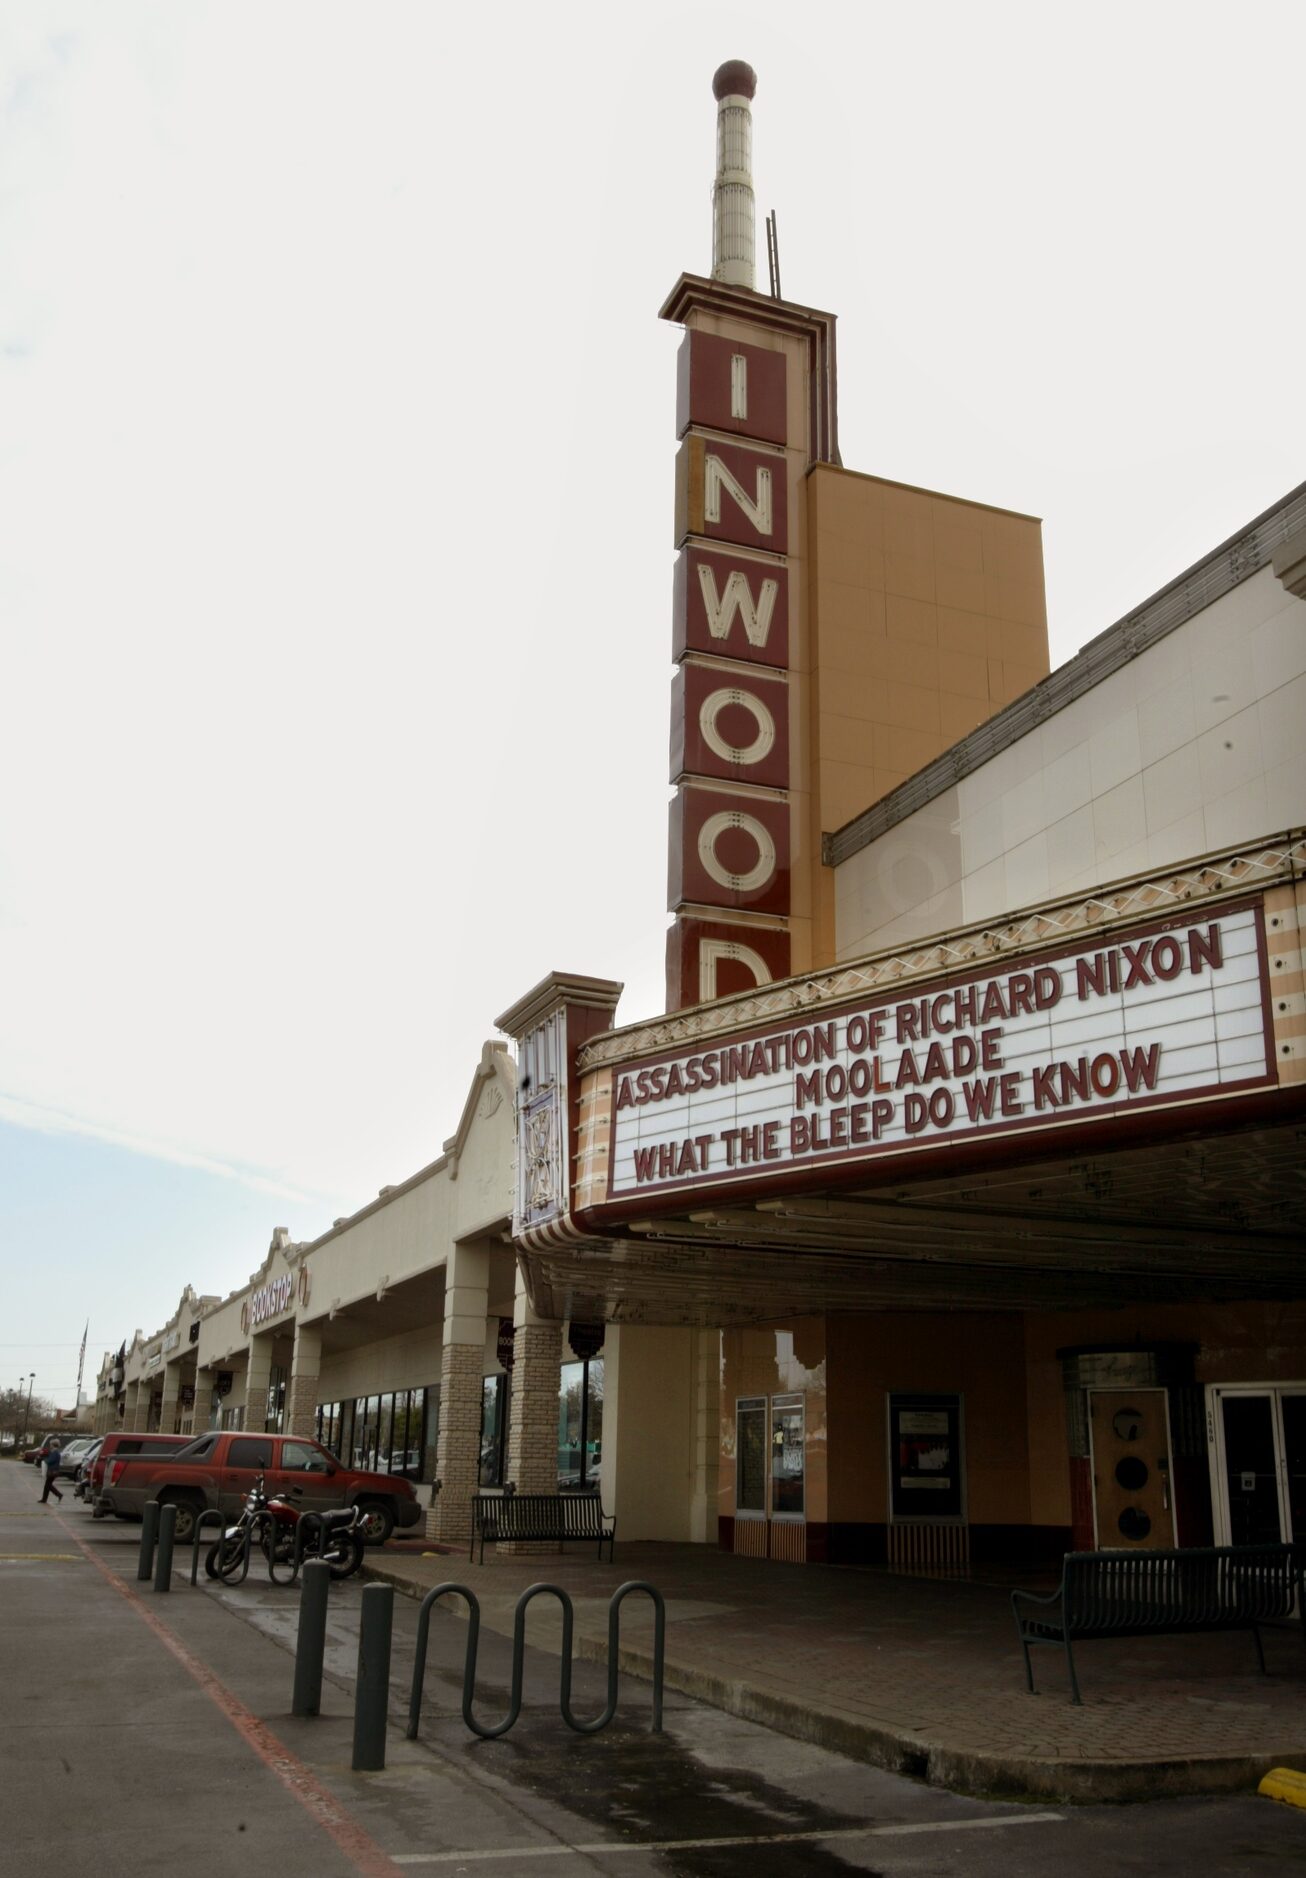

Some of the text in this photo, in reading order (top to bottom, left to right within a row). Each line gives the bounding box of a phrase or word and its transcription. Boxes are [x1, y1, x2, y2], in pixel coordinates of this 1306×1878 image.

[698, 354, 778, 1001] INWOOD
[617, 923, 1223, 1110] ASSASSINATION OF RICHARD NIXON
[796, 1027, 1005, 1110] MOOLAADE
[634, 1042, 1162, 1182] WHAT THE BLEEP DO WE KNOW
[251, 1272, 292, 1325] BOOKSTOP
